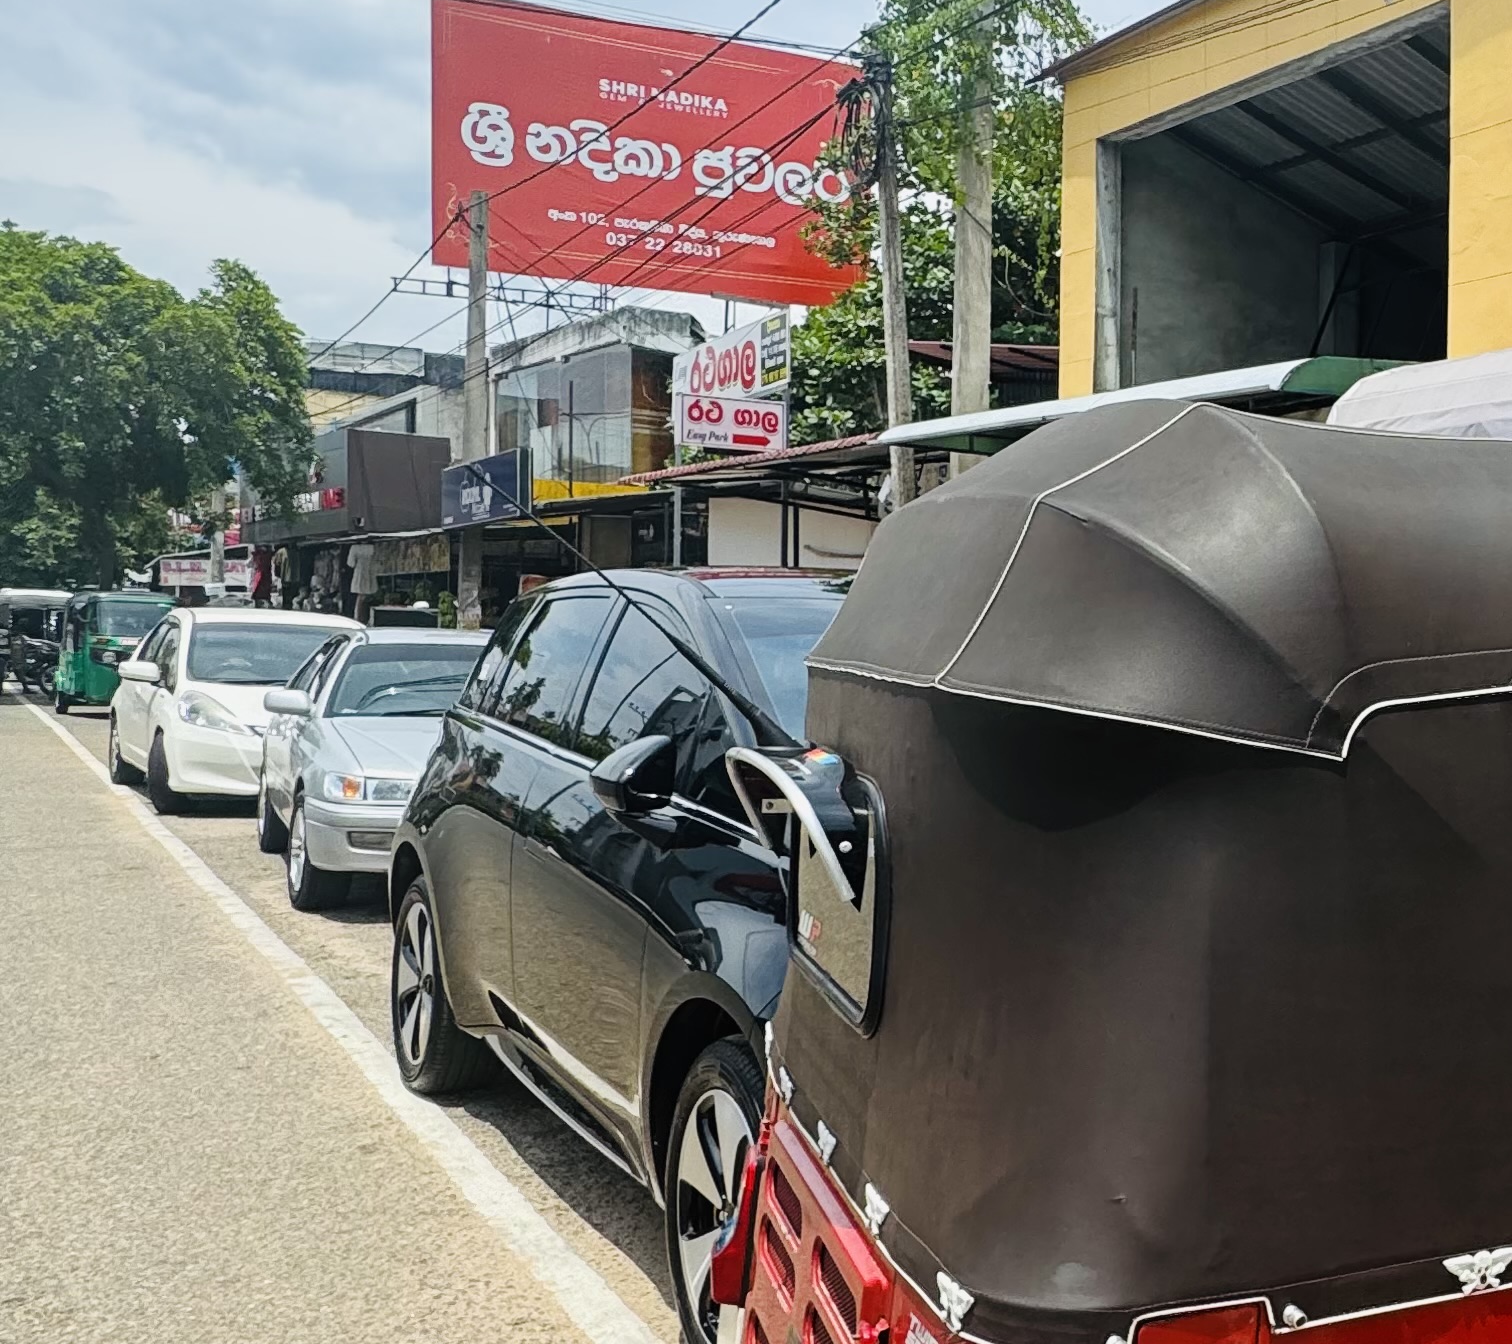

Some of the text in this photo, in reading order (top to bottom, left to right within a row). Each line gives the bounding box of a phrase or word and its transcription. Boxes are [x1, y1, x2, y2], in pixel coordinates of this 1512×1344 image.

[598, 78, 728, 112] SHRI NADIKA
[658, 103, 729, 119] JEWELLERY
[734, 408, 779, 434] ගාල
[708, 431, 729, 443] Park
